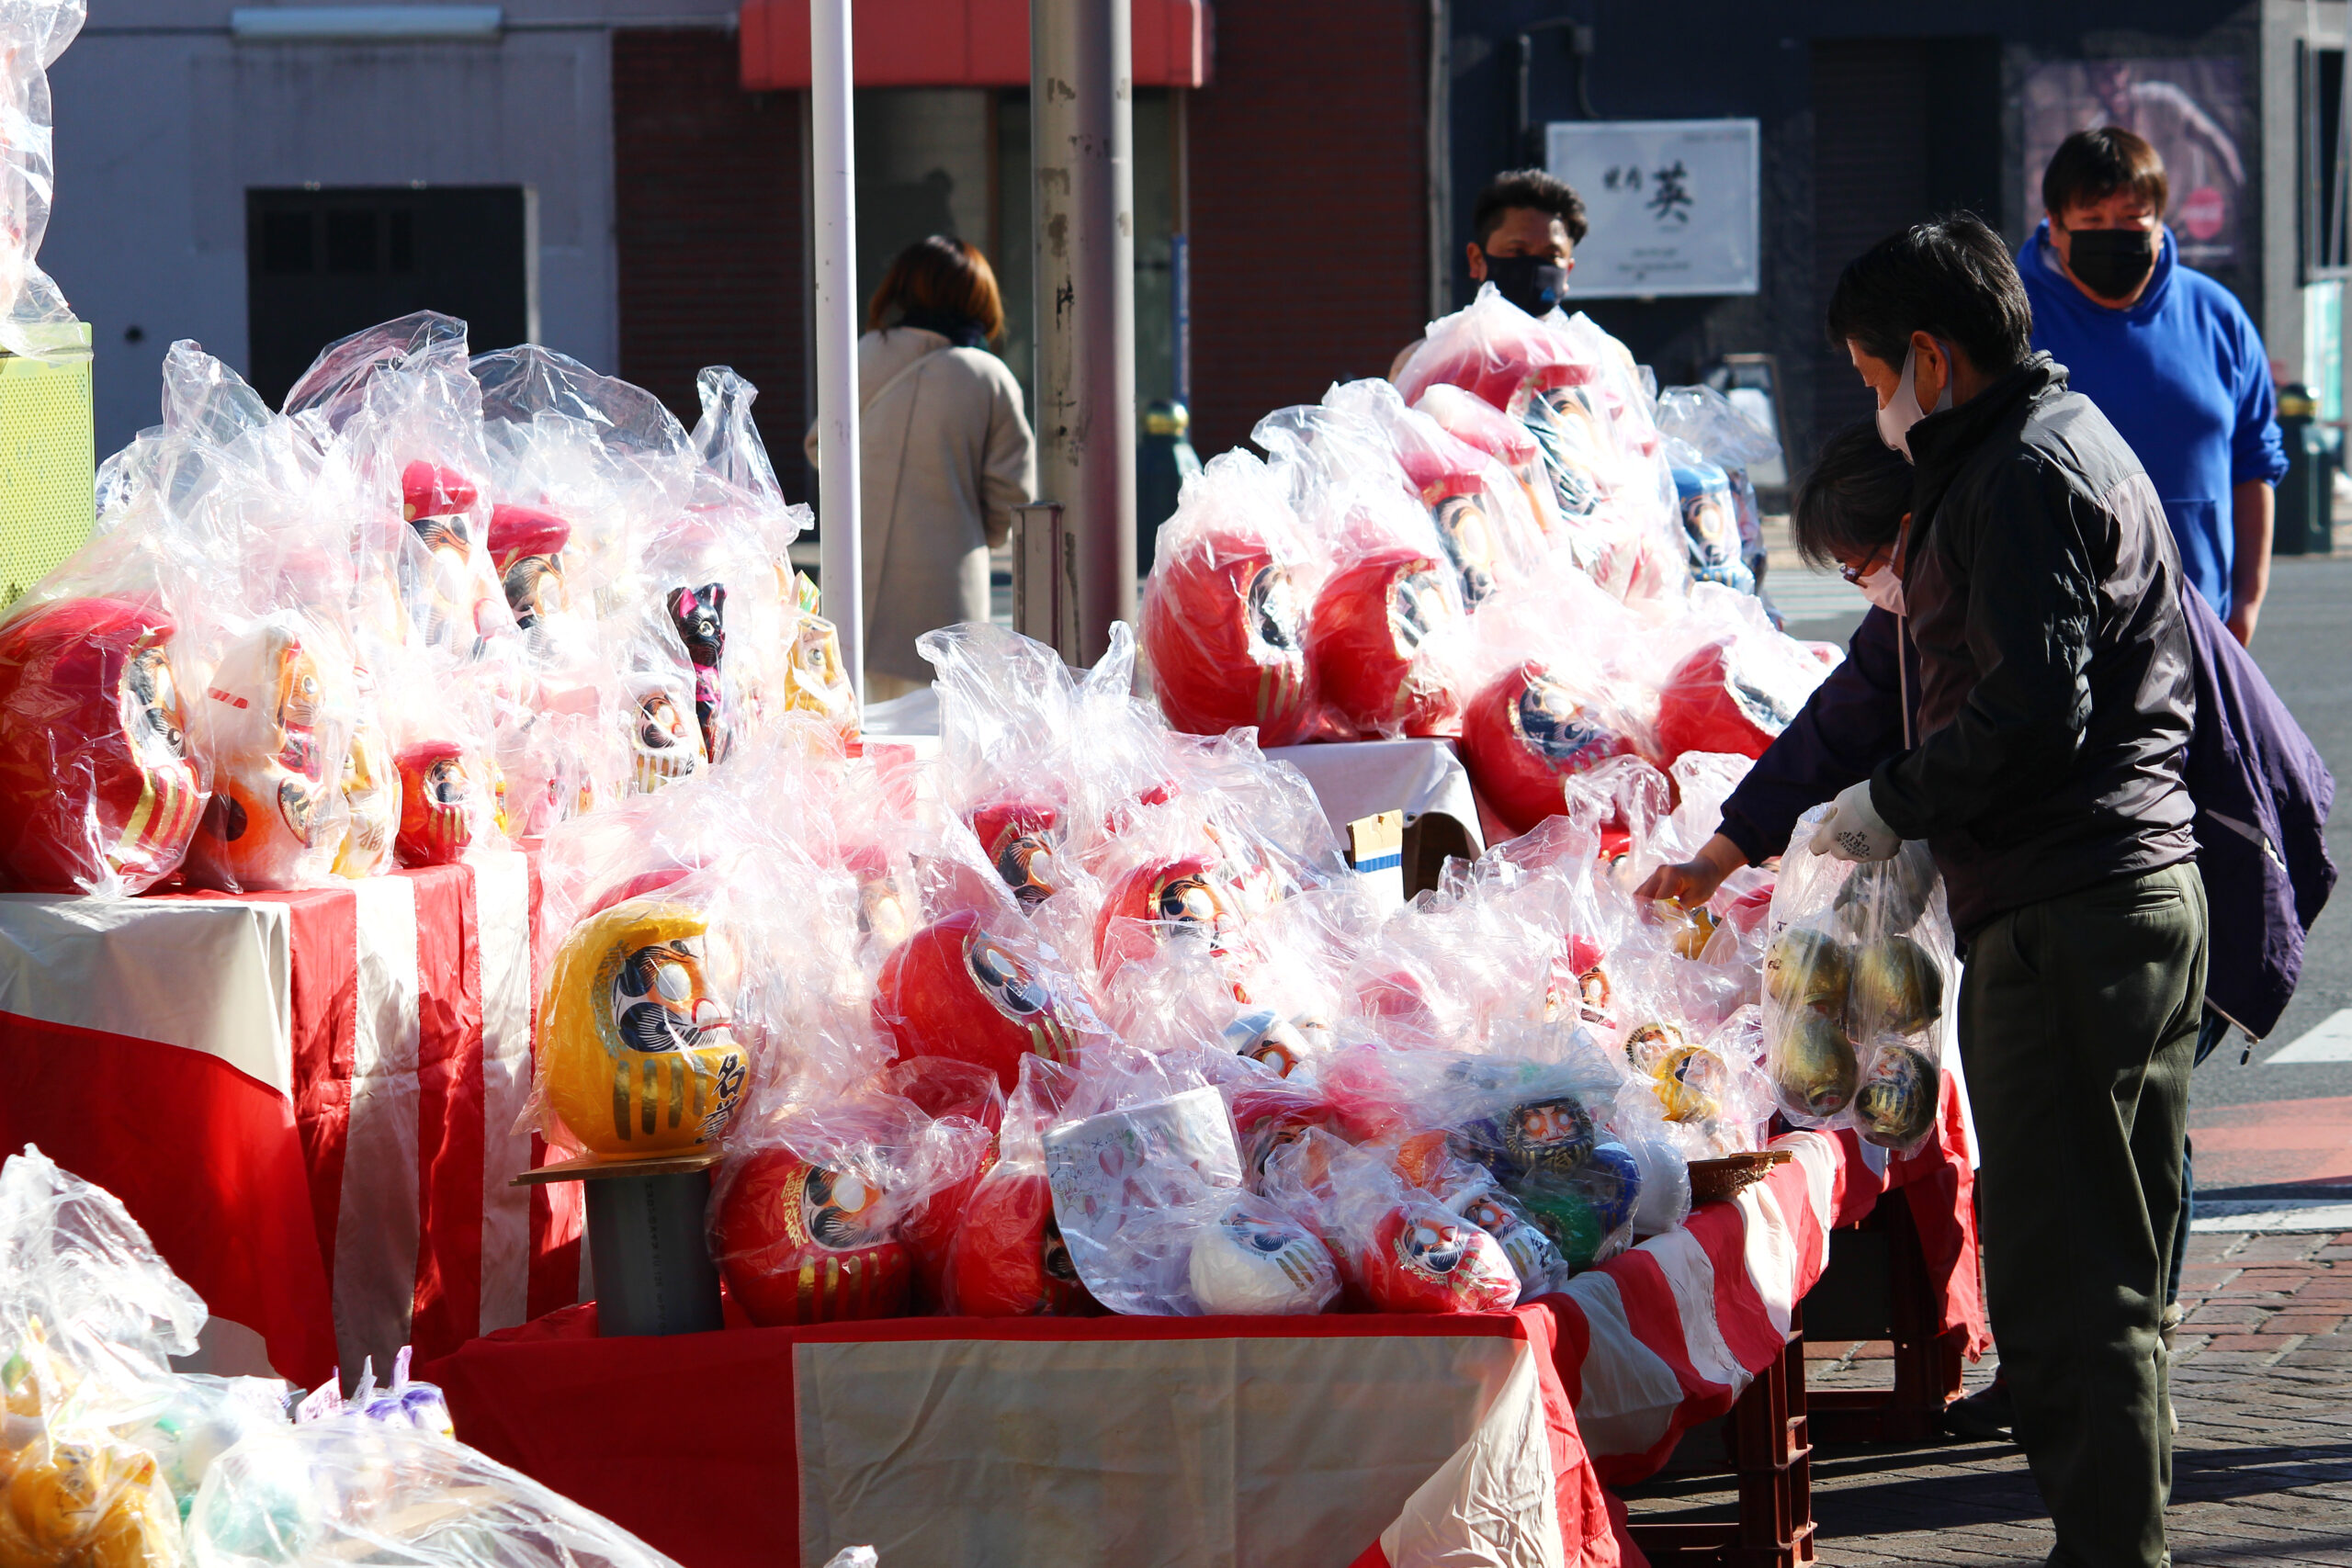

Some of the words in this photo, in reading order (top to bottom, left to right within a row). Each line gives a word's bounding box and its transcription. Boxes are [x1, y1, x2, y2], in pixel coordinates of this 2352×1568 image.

[1645, 160, 1693, 222] 英
[1843, 831, 1870, 852] GRIP
[1857, 830, 1867, 841] M
[1541, 1145, 1574, 1175] 福
